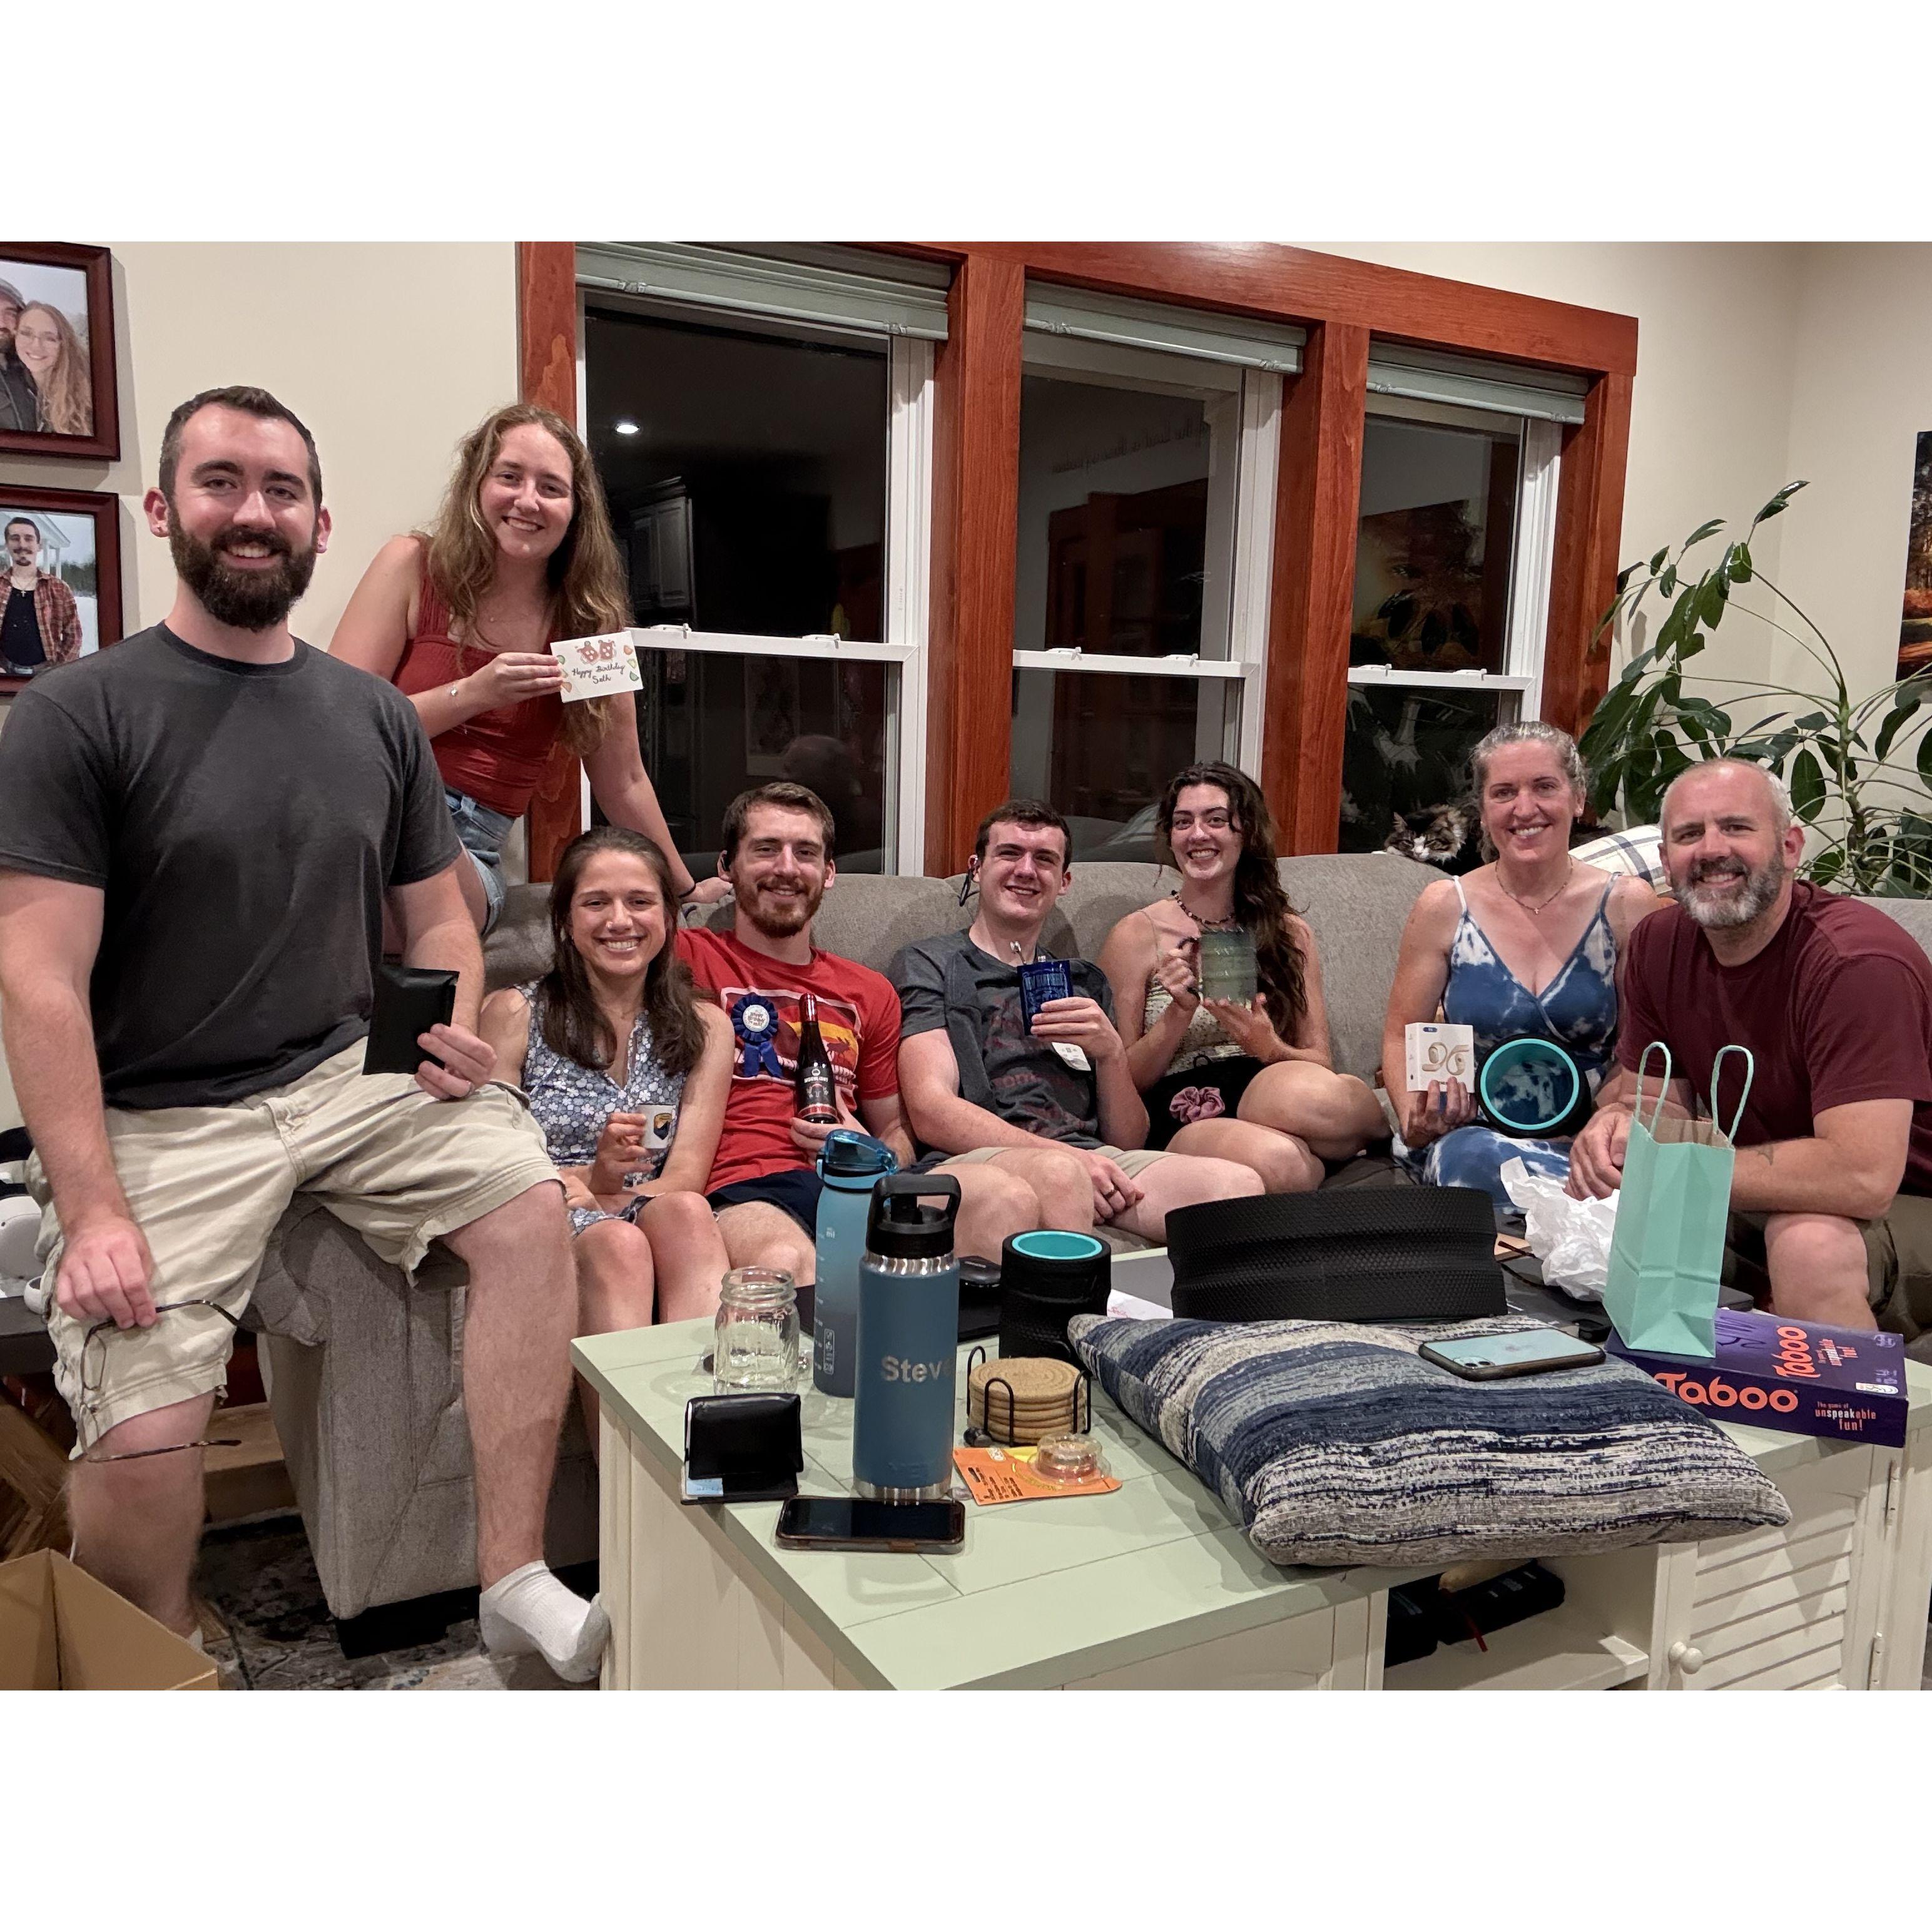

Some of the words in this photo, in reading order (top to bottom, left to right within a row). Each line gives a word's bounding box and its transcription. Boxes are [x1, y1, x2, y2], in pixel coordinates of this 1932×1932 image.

[595, 662, 625, 675] Birthday
[1772, 1326, 1821, 1378] Taboo
[1654, 1371, 1799, 1413] Taboo
[1815, 1408, 1876, 1420] unspeakable
[1838, 1418, 1863, 1431] fun!
